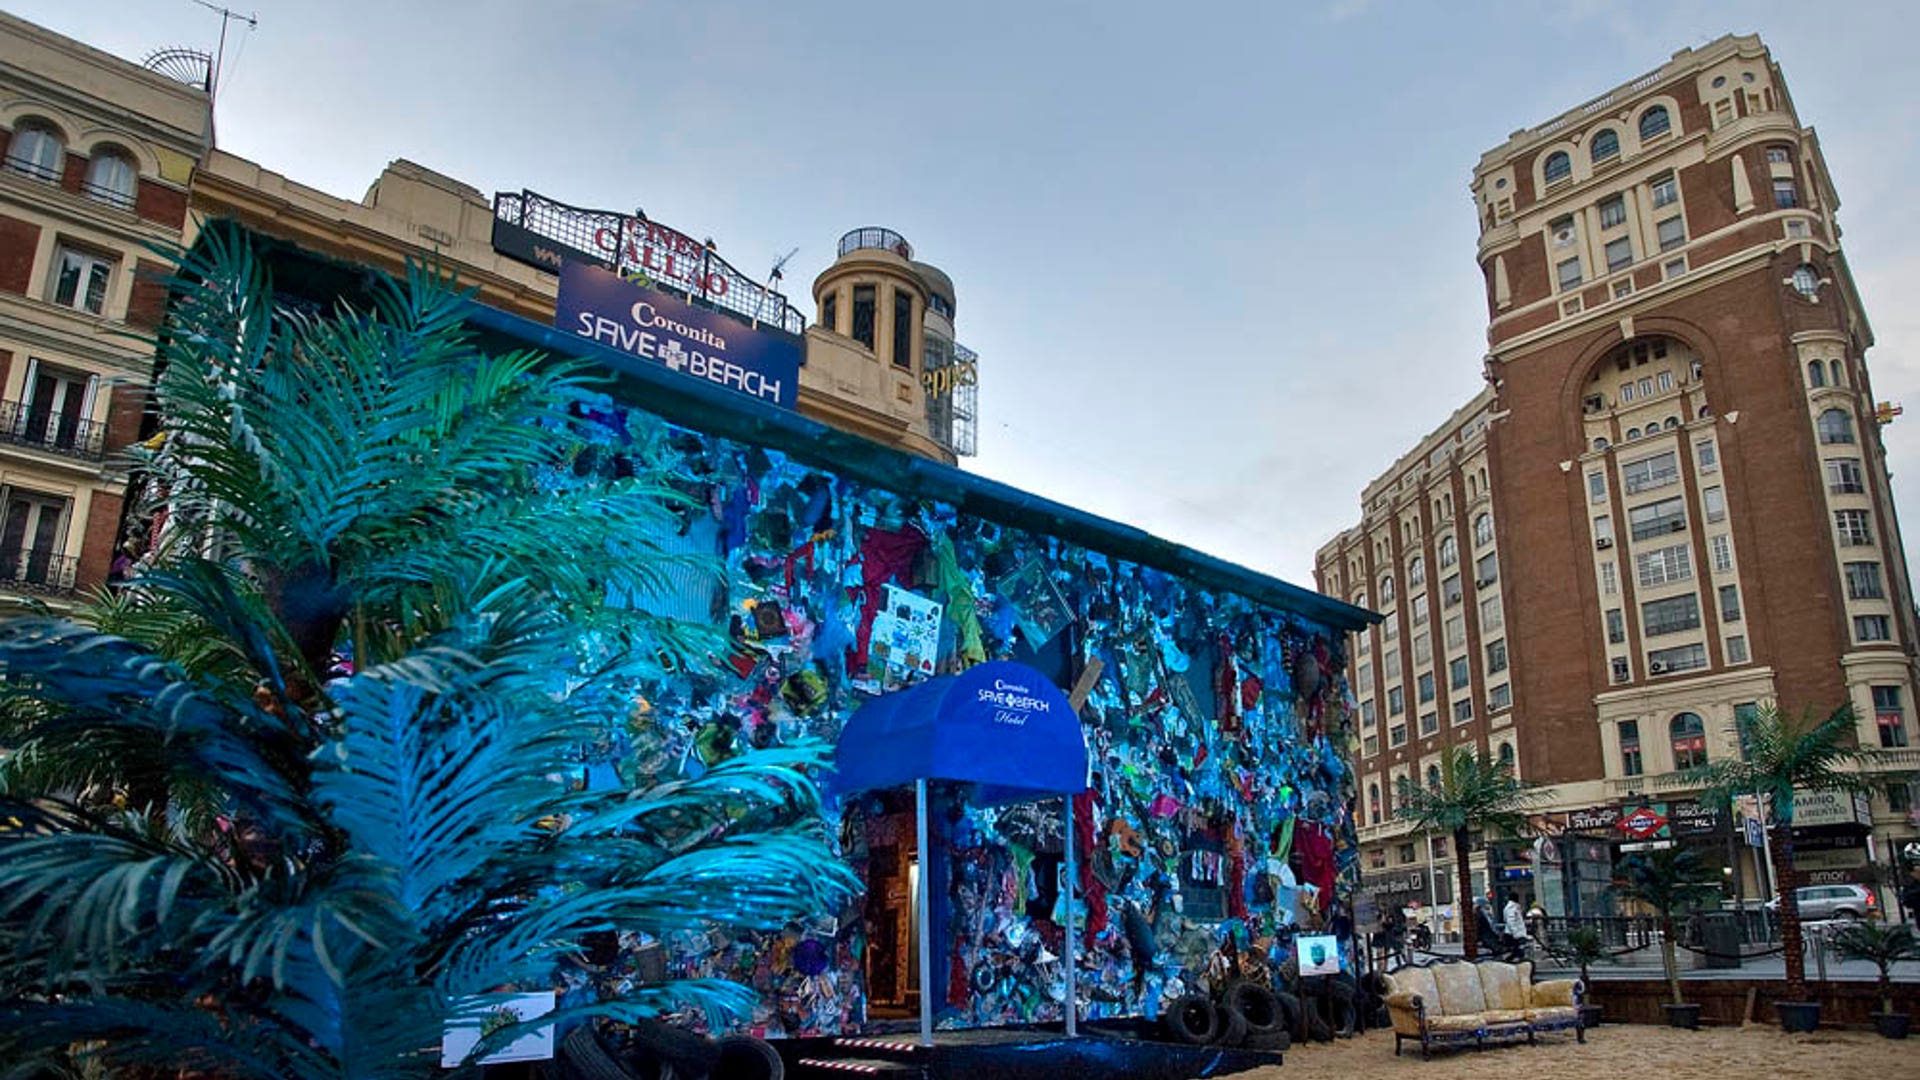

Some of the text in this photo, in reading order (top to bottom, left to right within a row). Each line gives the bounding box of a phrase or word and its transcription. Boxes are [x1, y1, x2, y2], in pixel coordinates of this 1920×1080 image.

[595, 228, 728, 296] CALLAO
[577, 312, 781, 404] SAVE BEACH
[631, 302, 726, 351] Coronita
